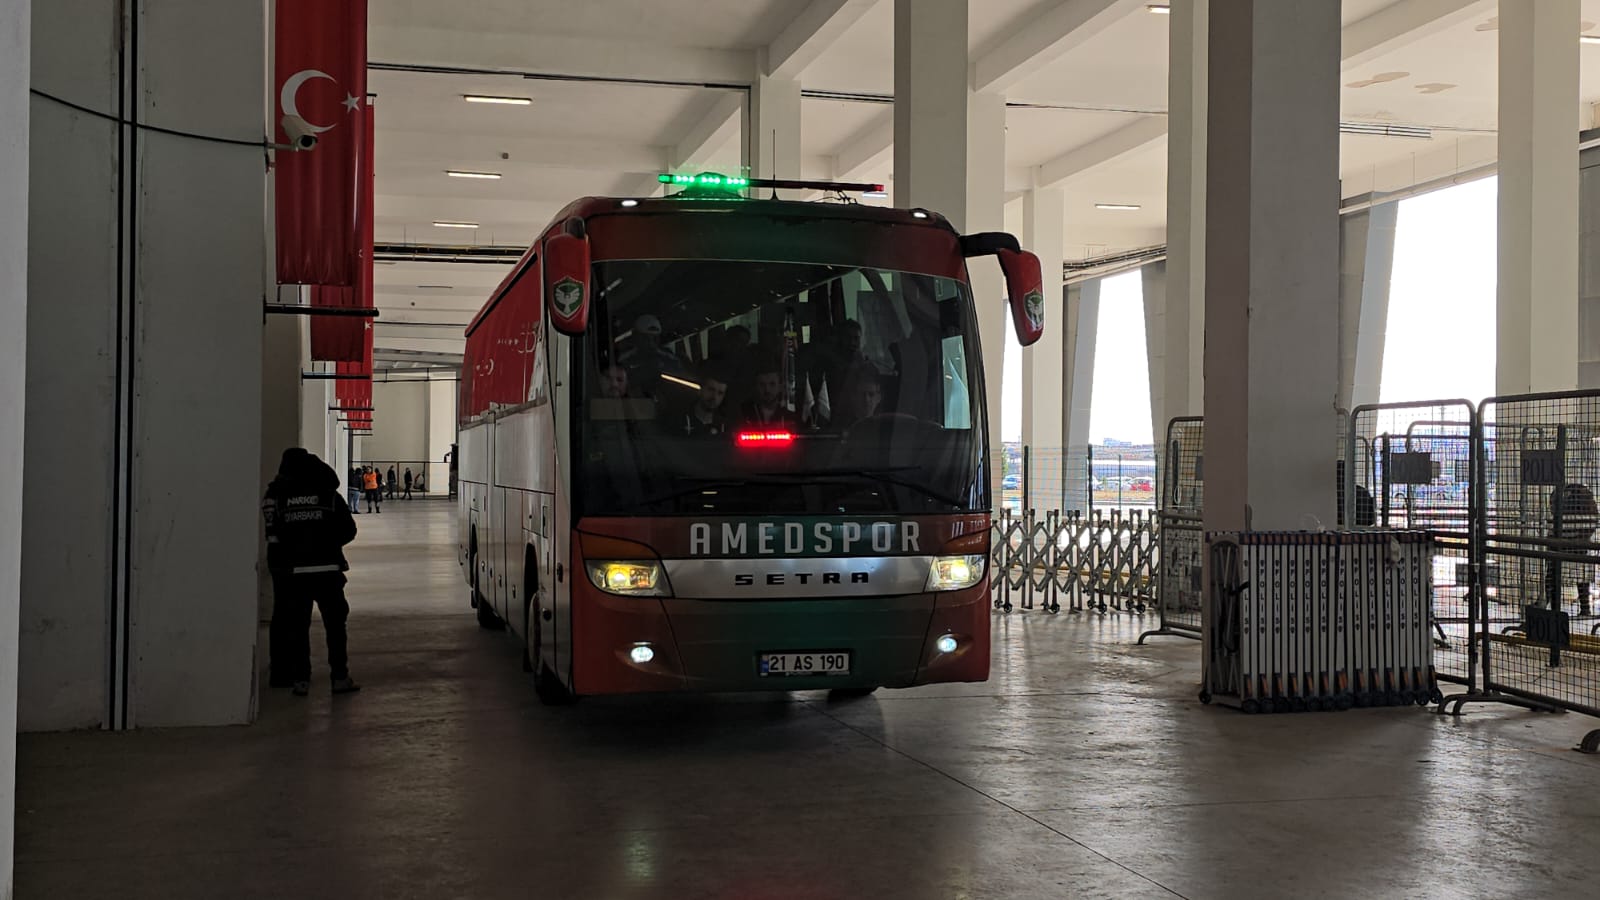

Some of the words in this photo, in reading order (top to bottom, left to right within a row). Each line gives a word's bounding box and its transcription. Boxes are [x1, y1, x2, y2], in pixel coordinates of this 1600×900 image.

[690, 522, 920, 555] AMEDSPOR
[735, 572, 869, 586] SETRA
[770, 655, 786, 671] 21
[794, 655, 813, 670] AS
[820, 655, 844, 670] 190
